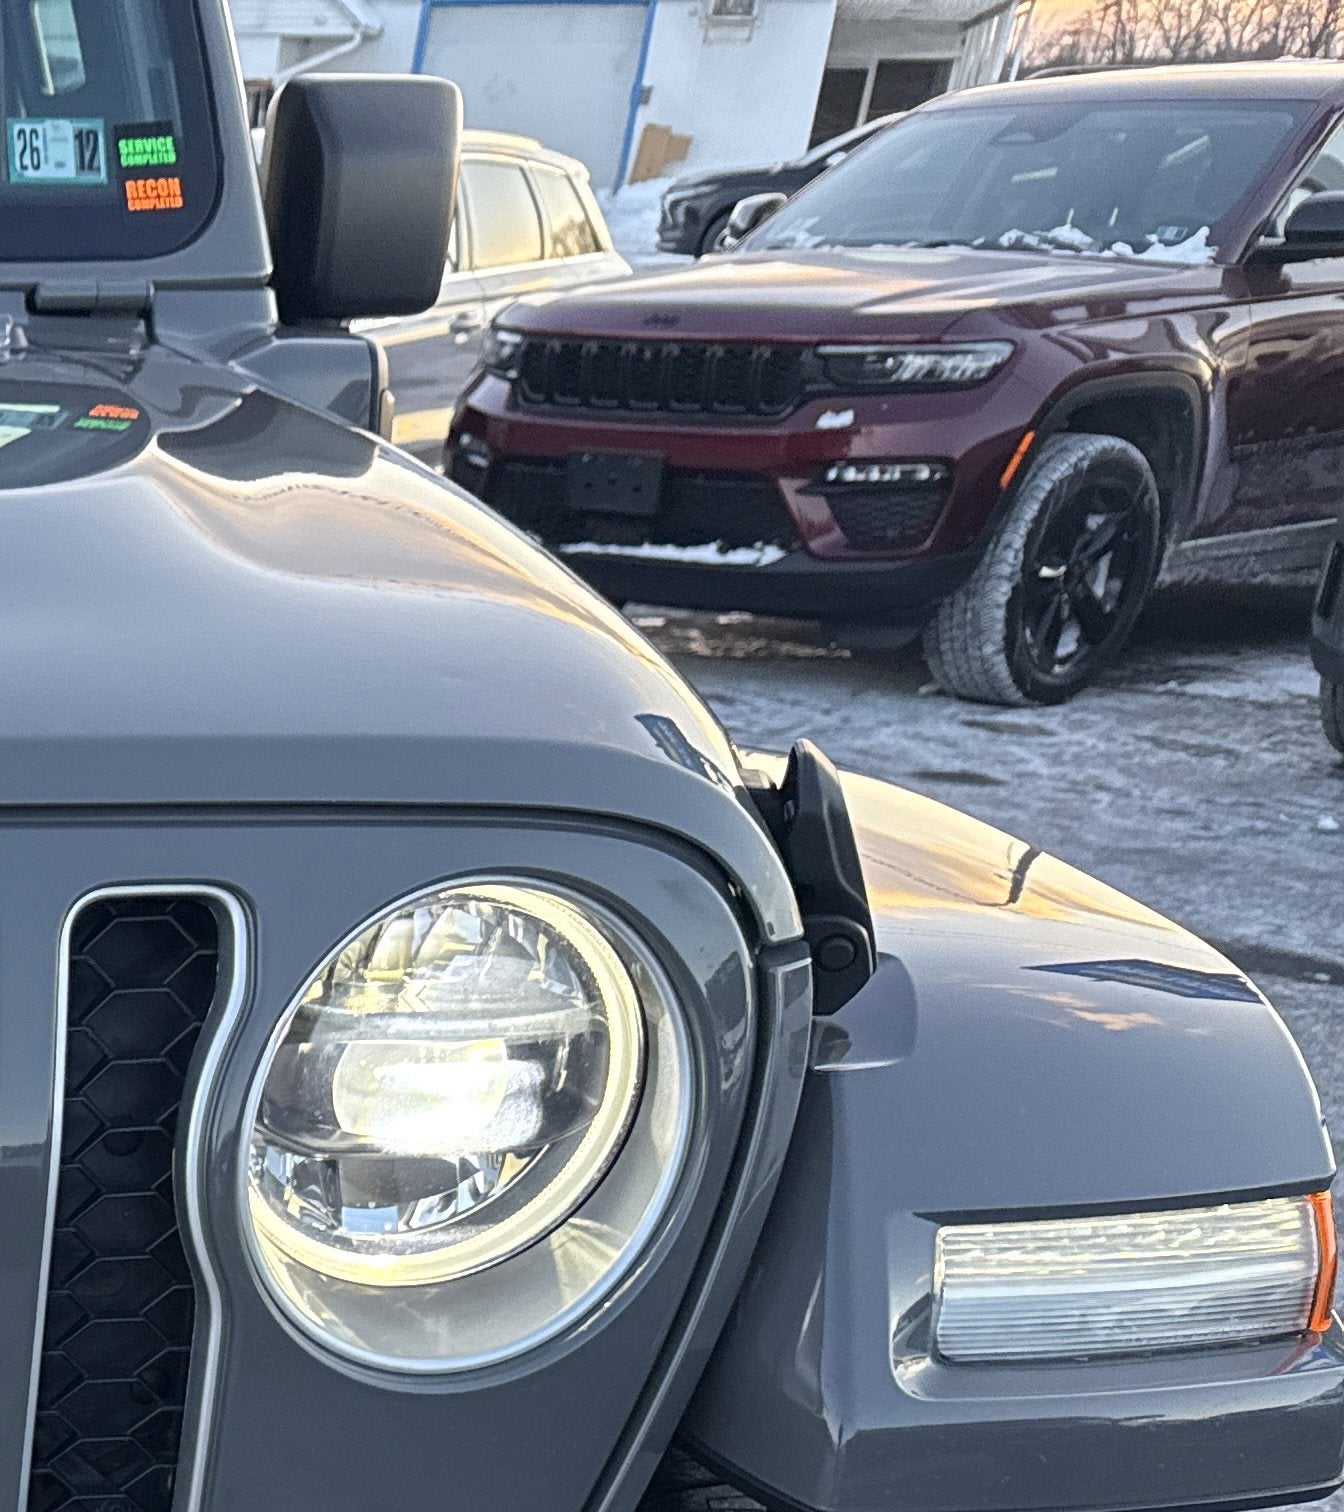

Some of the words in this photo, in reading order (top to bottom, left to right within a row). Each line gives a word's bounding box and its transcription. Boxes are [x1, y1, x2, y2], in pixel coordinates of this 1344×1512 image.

[17, 127, 41, 171] 26
[74, 128, 99, 172] 12
[118, 135, 174, 154] SERVICE
[125, 177, 181, 199] RECON
